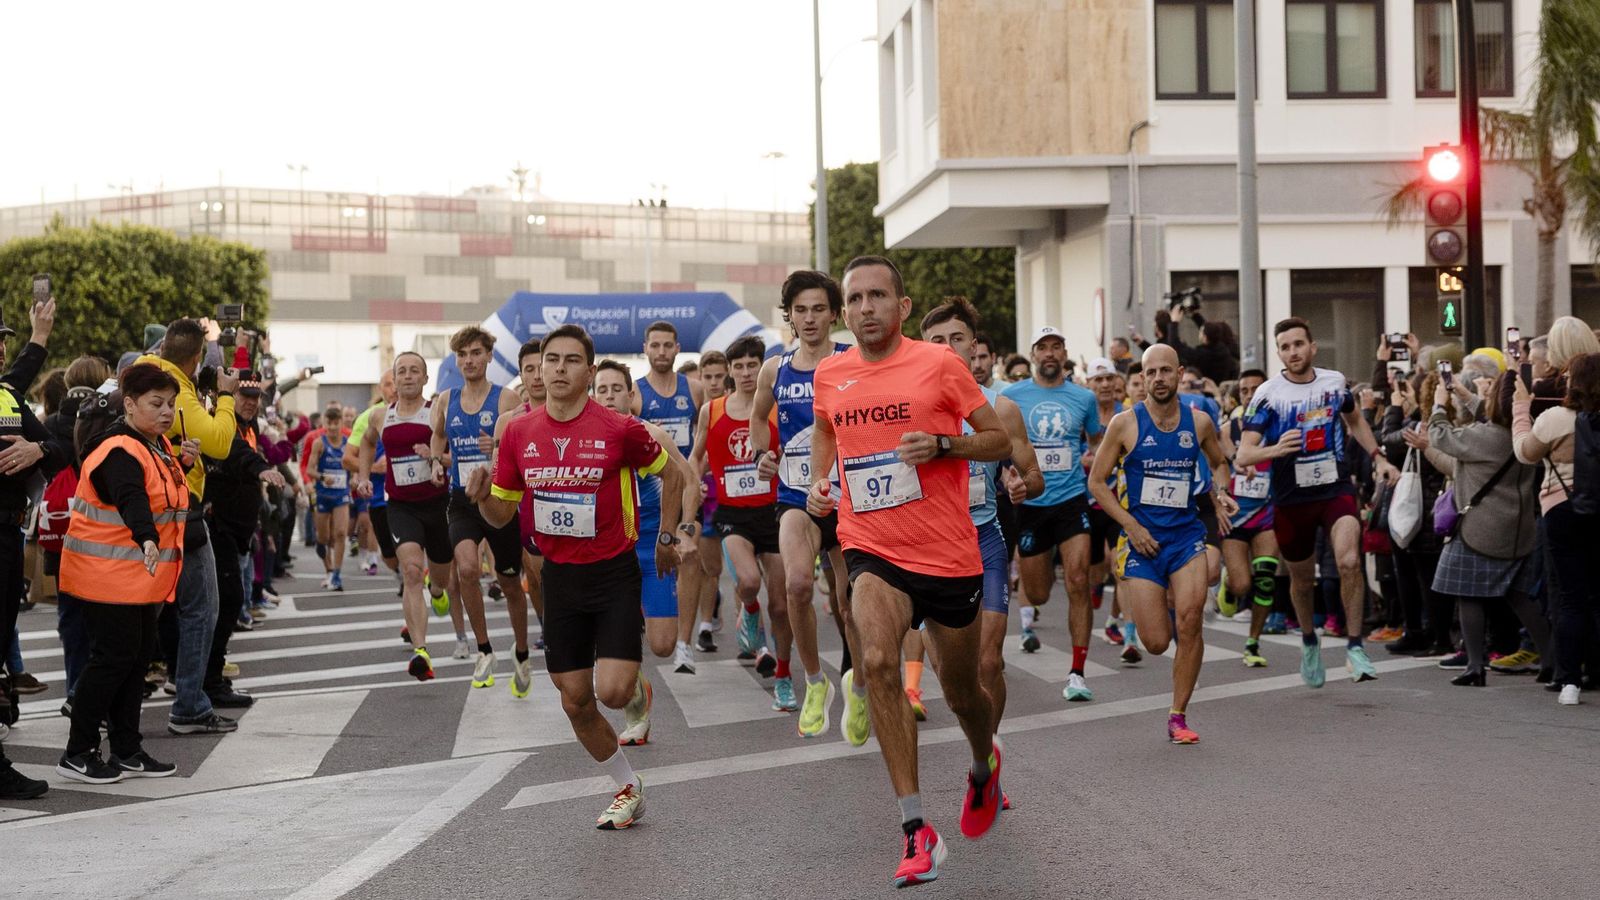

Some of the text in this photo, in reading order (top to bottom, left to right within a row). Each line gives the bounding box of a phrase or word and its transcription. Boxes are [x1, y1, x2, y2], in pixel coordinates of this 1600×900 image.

[571, 306, 630, 320] Diputación
[638, 306, 696, 319] DEPORTES
[588, 321, 619, 335] Cádiz
[1045, 453, 1061, 465] 99
[407, 467, 416, 478] 6
[524, 466, 604, 481] ISBILYA
[1313, 467, 1322, 479] 5
[739, 476, 756, 489] 69
[866, 475, 892, 498] 97
[1158, 486, 1176, 499] 17
[551, 510, 575, 527] 88
